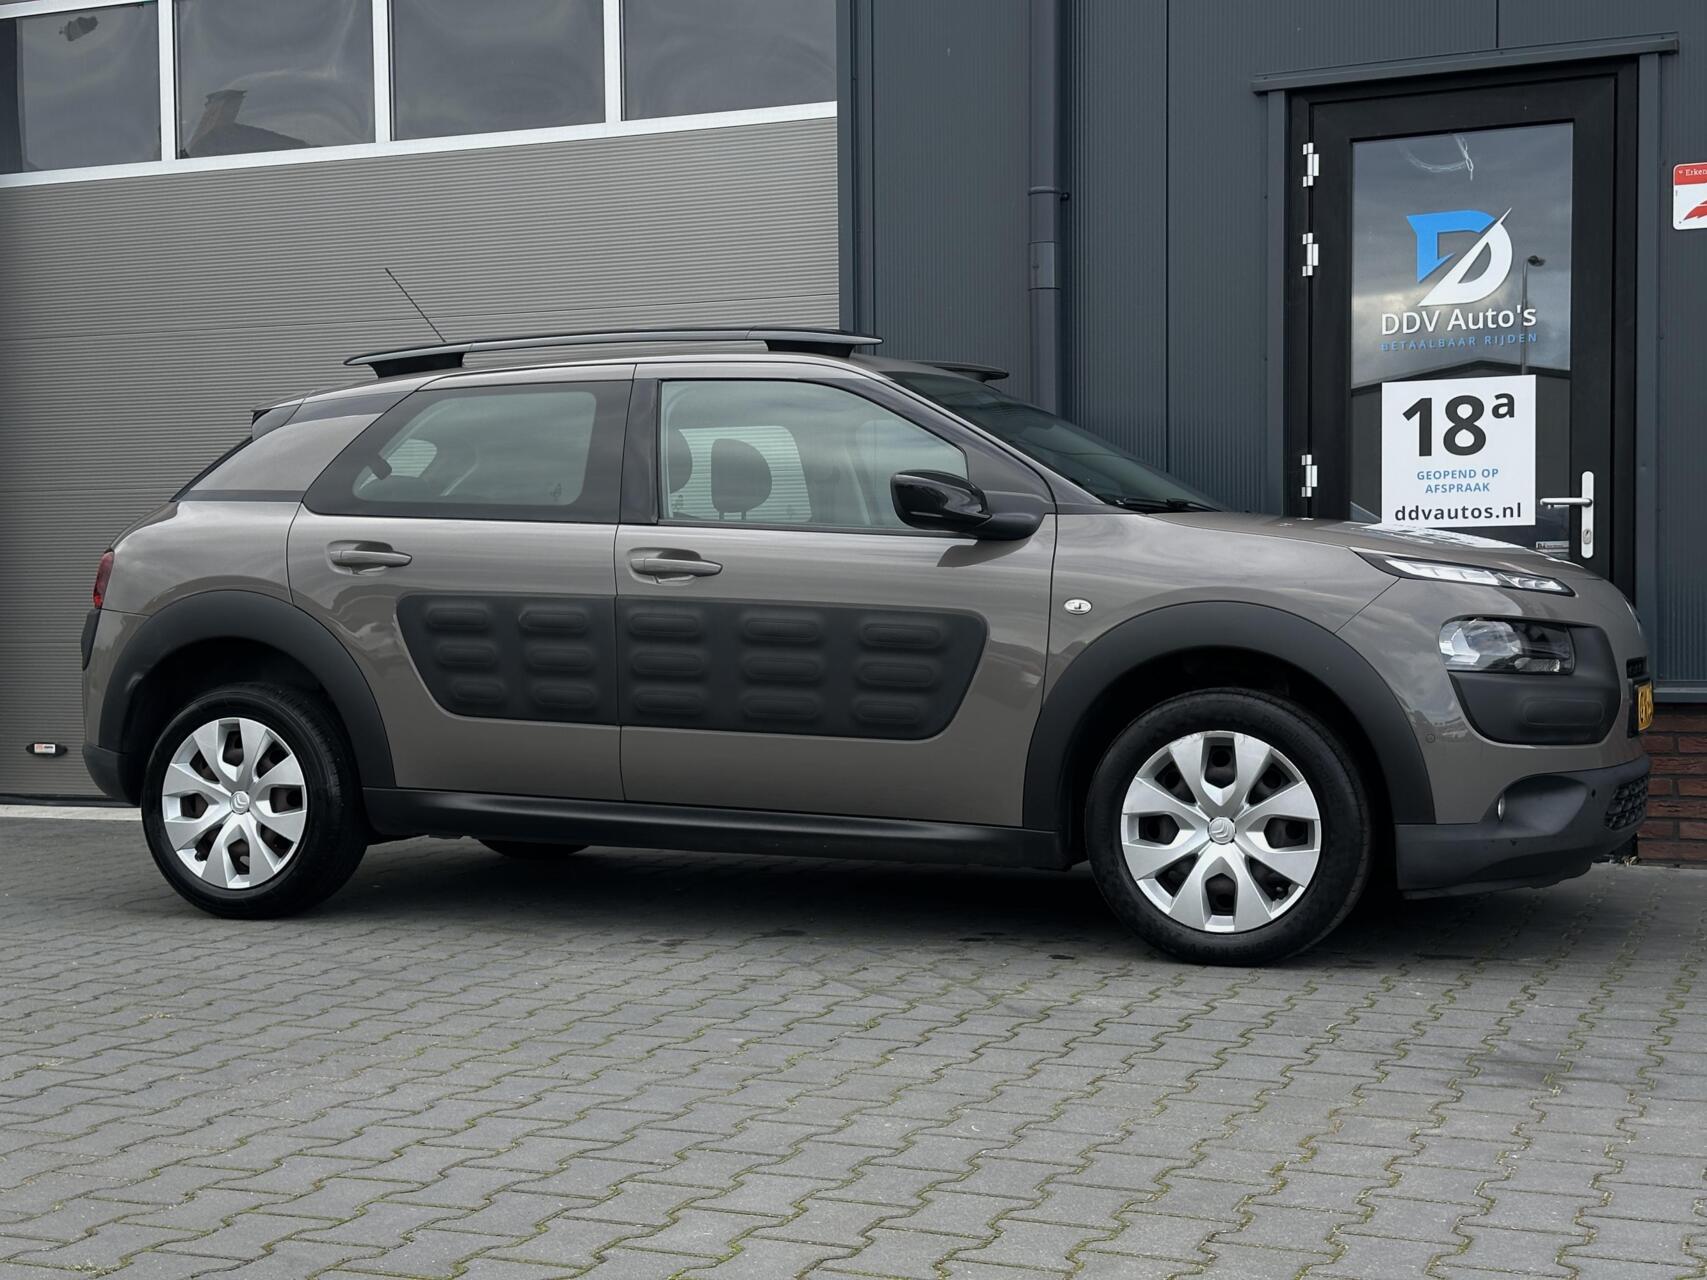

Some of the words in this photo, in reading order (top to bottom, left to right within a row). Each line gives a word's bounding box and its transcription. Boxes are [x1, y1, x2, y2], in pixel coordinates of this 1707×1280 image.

[1381, 310, 1440, 335] DDV
[1447, 304, 1537, 331] Auto's
[1381, 337, 1476, 352] BETAALBAAR
[1484, 331, 1537, 346] RIJDEN
[1417, 469, 1477, 480] GEOPEND
[1481, 468, 1499, 478] OP
[1425, 483, 1490, 493] AFSPRAAK
[1394, 502, 1522, 521] ddvautos.nl
